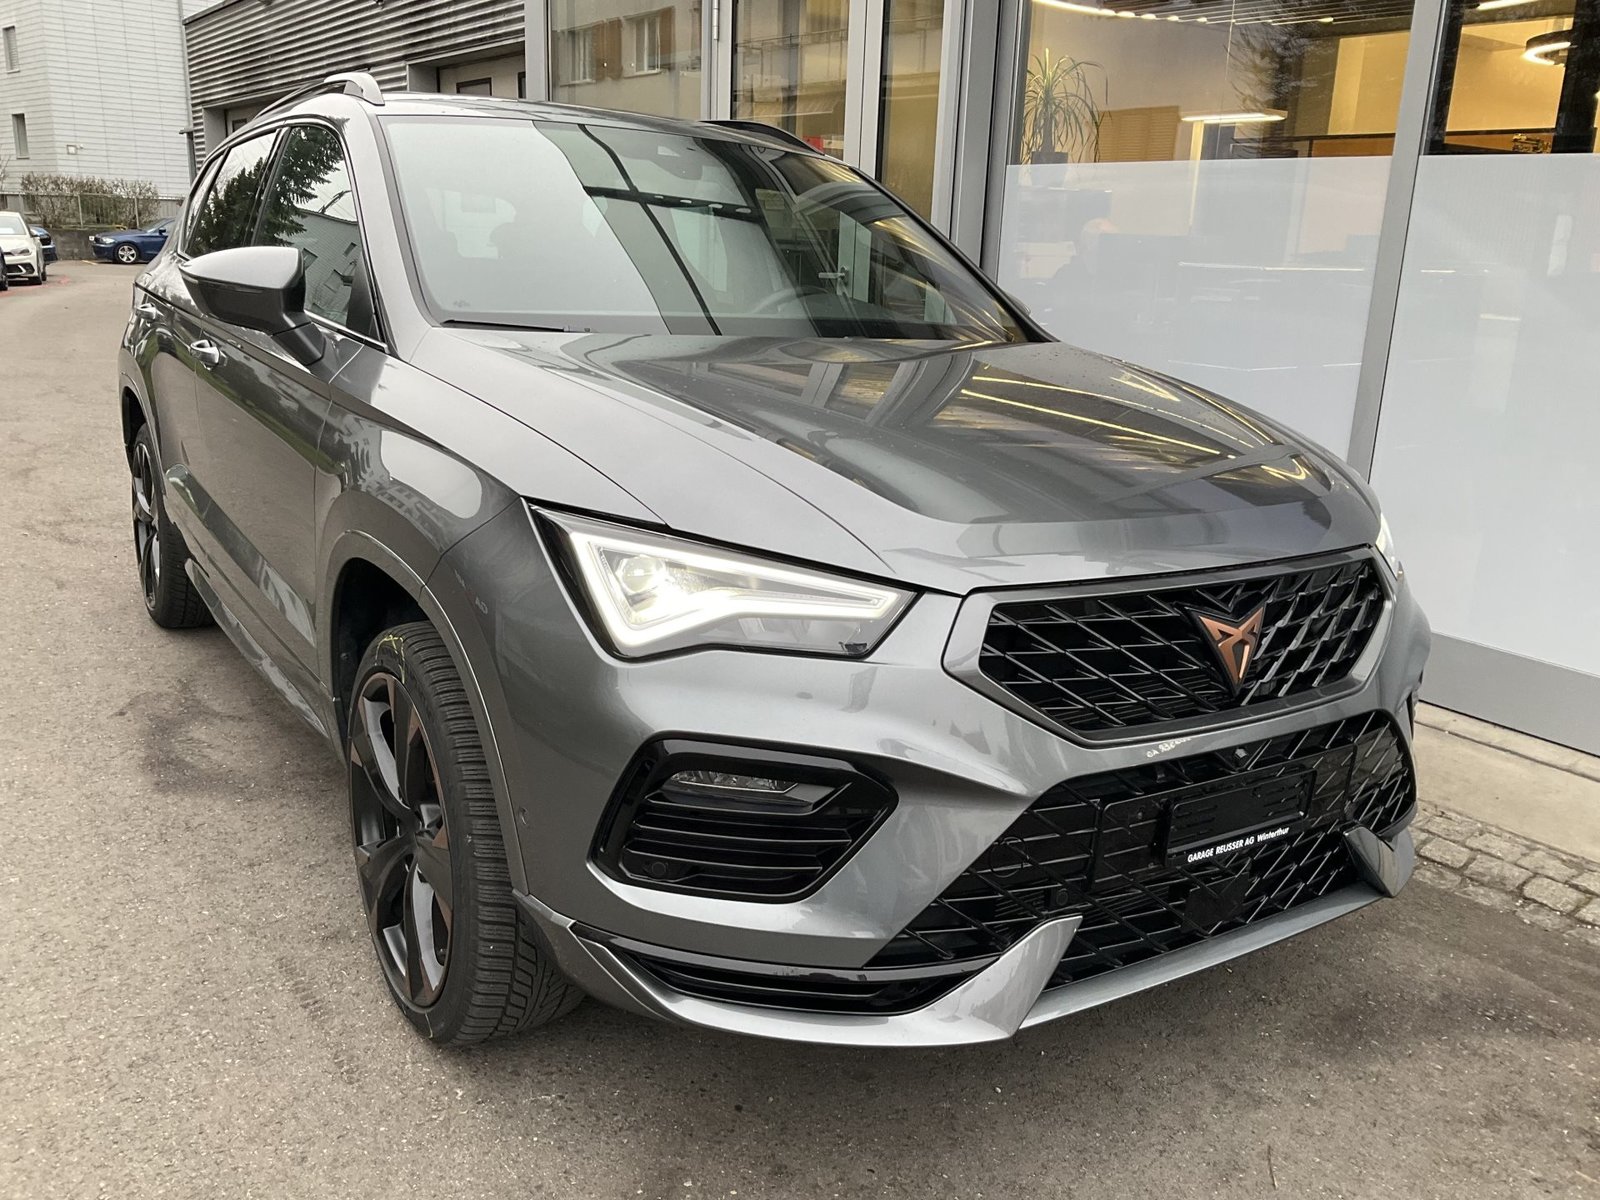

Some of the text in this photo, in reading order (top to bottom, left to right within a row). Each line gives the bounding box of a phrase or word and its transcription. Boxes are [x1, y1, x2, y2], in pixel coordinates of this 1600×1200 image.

[1187, 827, 1290, 863] GARAGE REUSSER AG Winterthur
